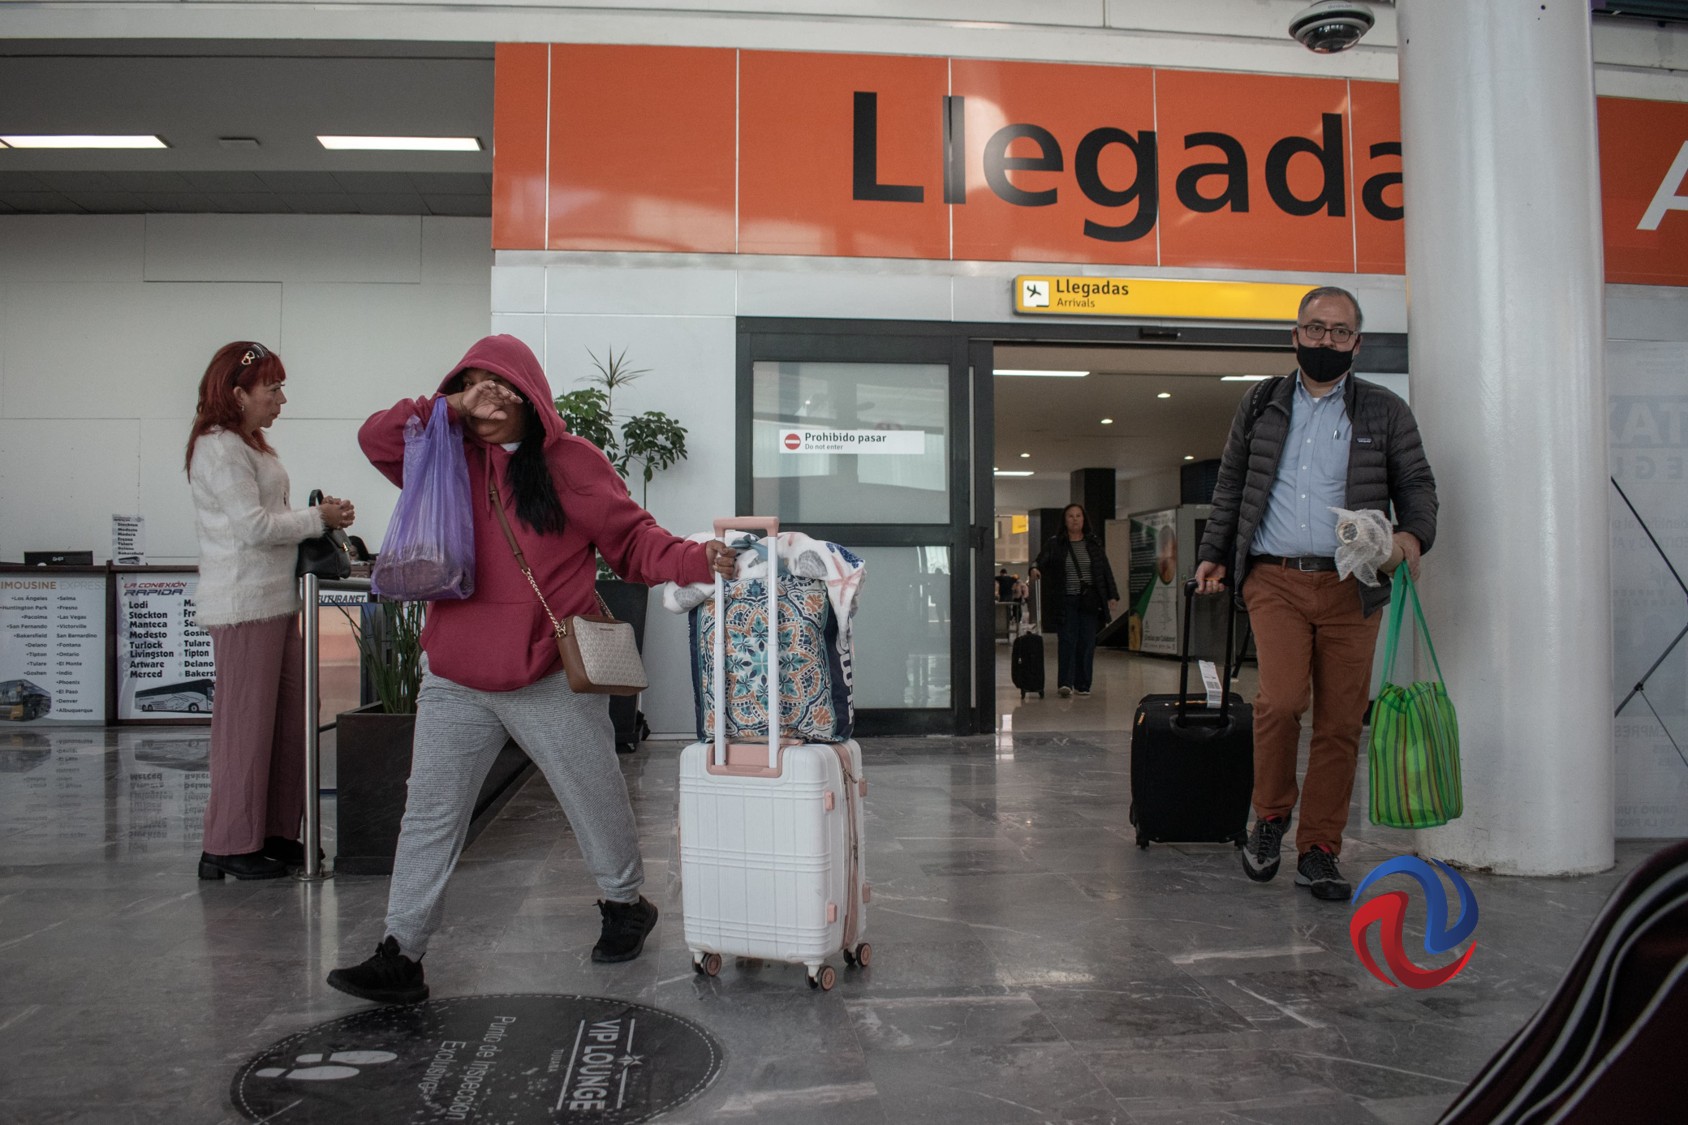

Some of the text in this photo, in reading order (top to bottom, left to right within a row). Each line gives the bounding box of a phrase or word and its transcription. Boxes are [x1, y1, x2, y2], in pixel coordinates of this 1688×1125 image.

[1056, 279, 1129, 298] Llegadas
[1057, 298, 1096, 308] Arrivals
[805, 432, 887, 444] Prohibido pasar
[138, 581, 187, 589] CONEXIÓN
[129, 601, 149, 609] Lodi
[129, 611, 168, 619] Stockton
[184, 619, 197, 627] Se
[129, 631, 168, 639] Modesto
[129, 641, 163, 649] Turlock
[130, 650, 174, 659] Livingston
[184, 649, 209, 658] Tipton
[130, 670, 163, 678] Merced
[483, 1016, 517, 1043] Punto
[476, 1044, 502, 1058] de
[568, 1019, 621, 1111] VIP LOUNGE
